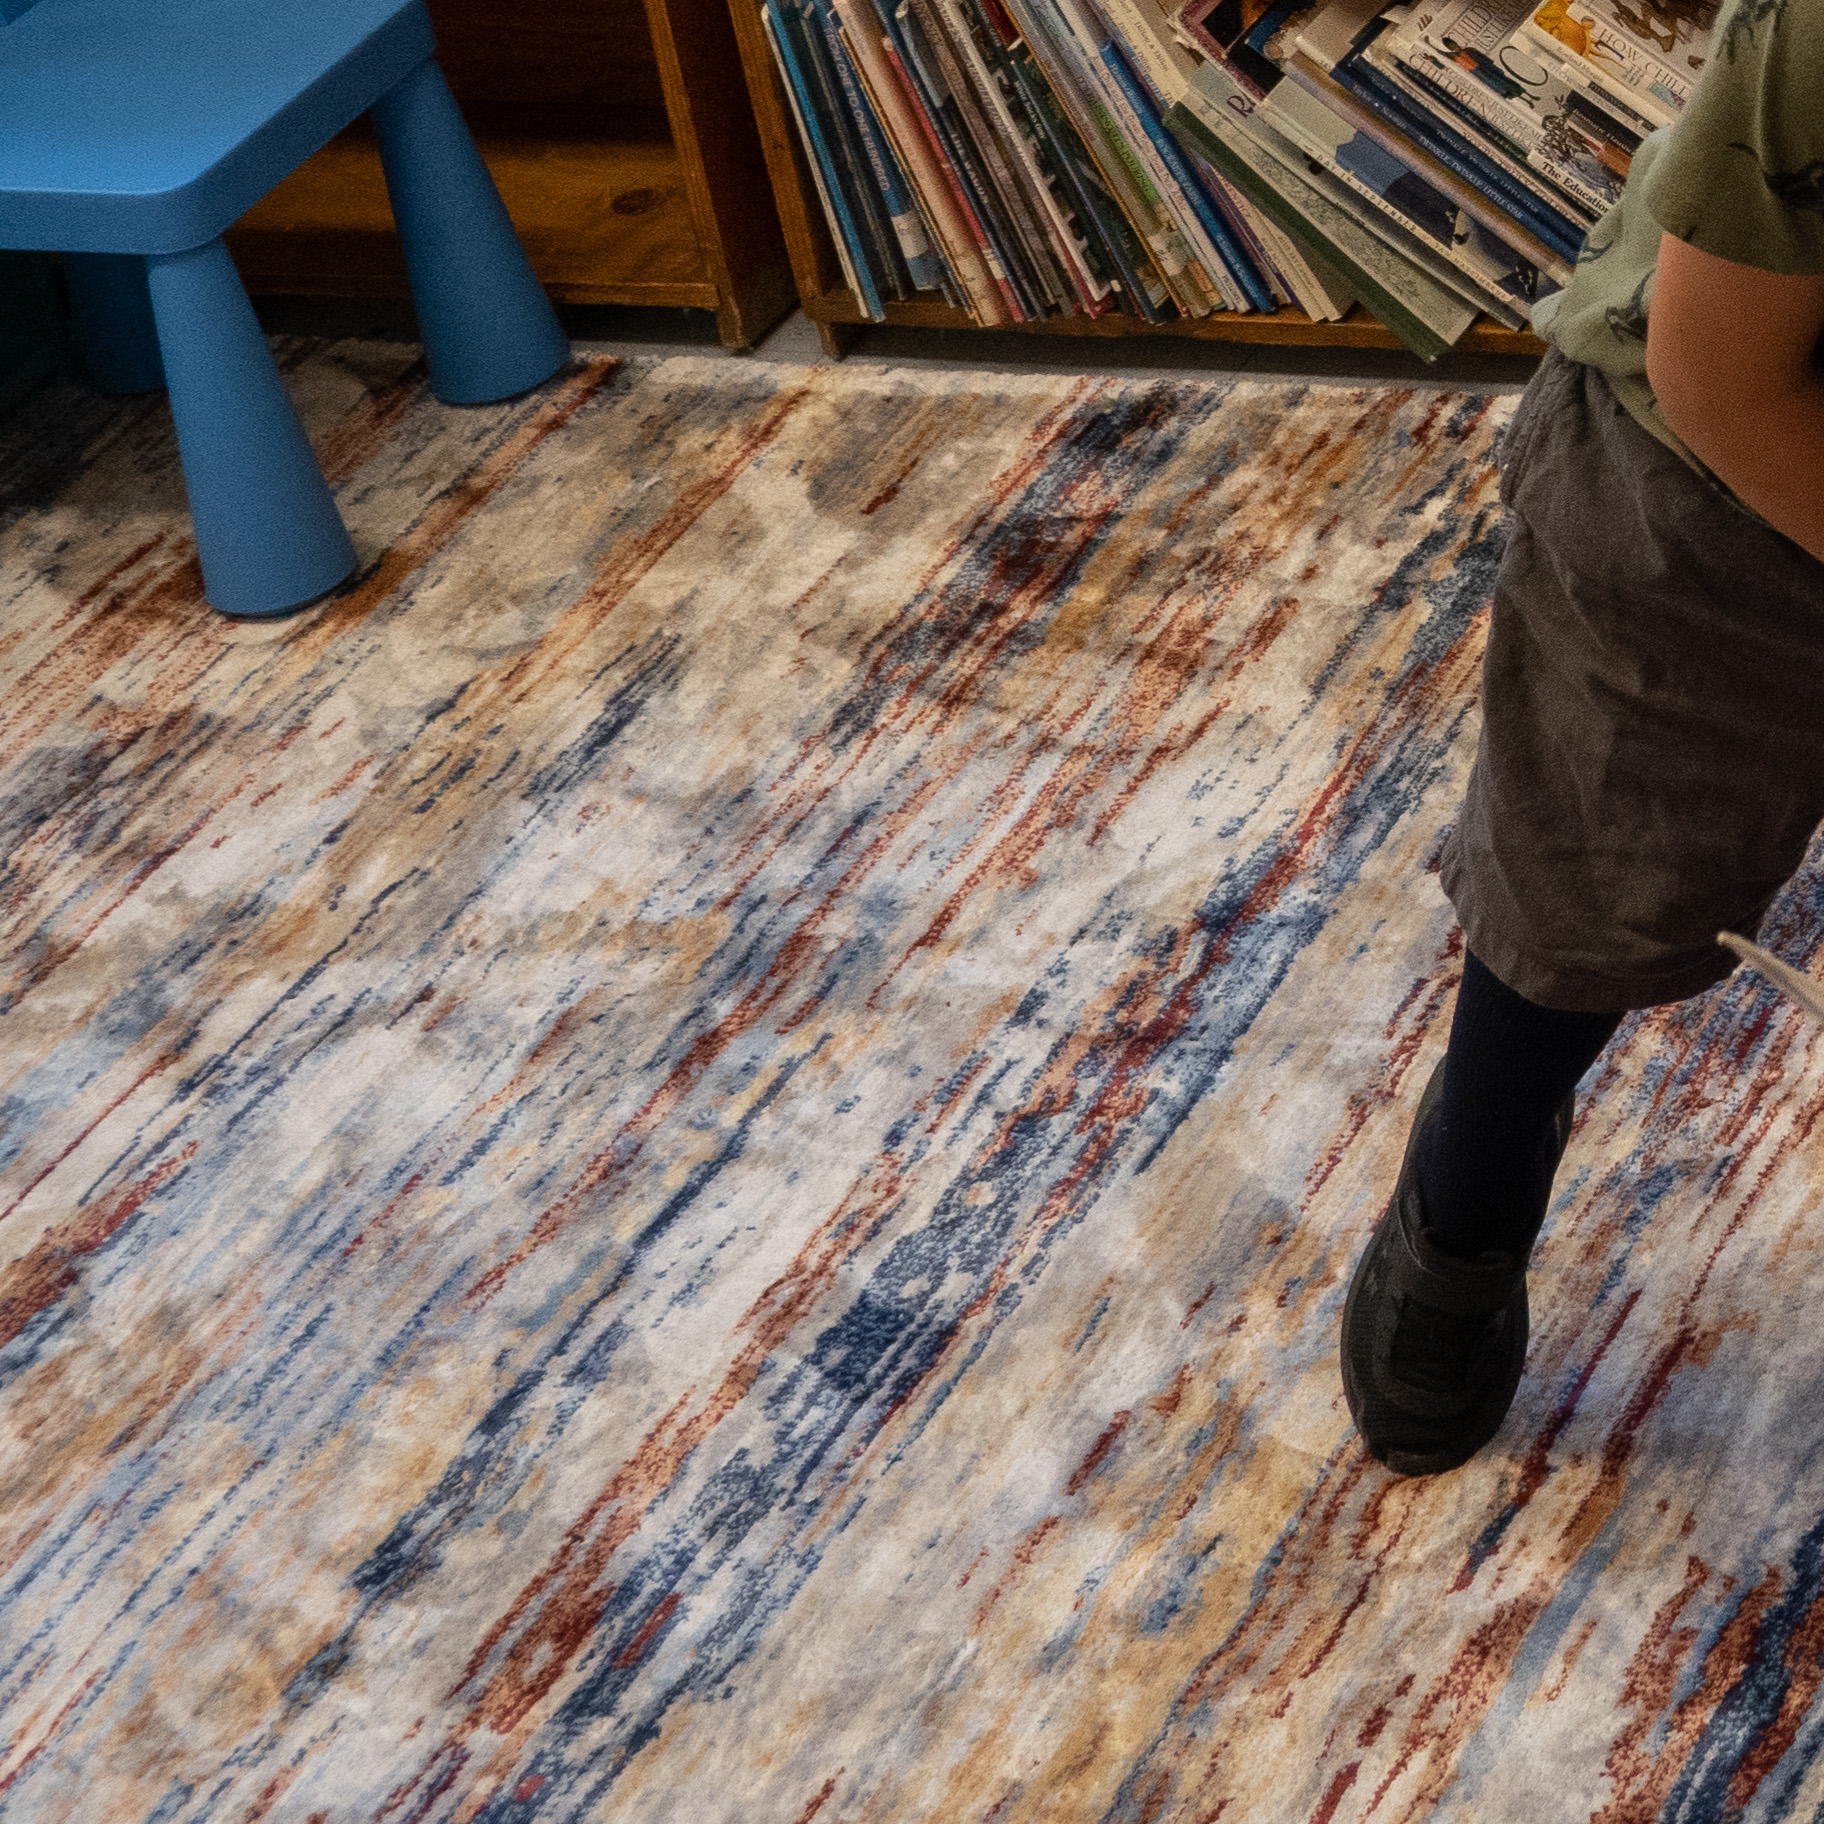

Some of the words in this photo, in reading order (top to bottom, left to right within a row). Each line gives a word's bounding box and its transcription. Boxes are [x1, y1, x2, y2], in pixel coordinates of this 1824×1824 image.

[820, 25, 847, 65] FROM
[1596, 27, 1645, 66] HOW
[835, 63, 855, 89] ONE
[1403, 53, 1495, 121] CHILDREN
[844, 87, 861, 107] TO
[850, 106, 871, 135] ONE
[860, 134, 893, 193] HUNDRED
[1314, 153, 1339, 173] DAY
[1355, 183, 1418, 232] SEPTEMBER
[1538, 160, 1565, 182] The
[1560, 174, 1614, 214] Education
[1504, 202, 1524, 220] STAR
